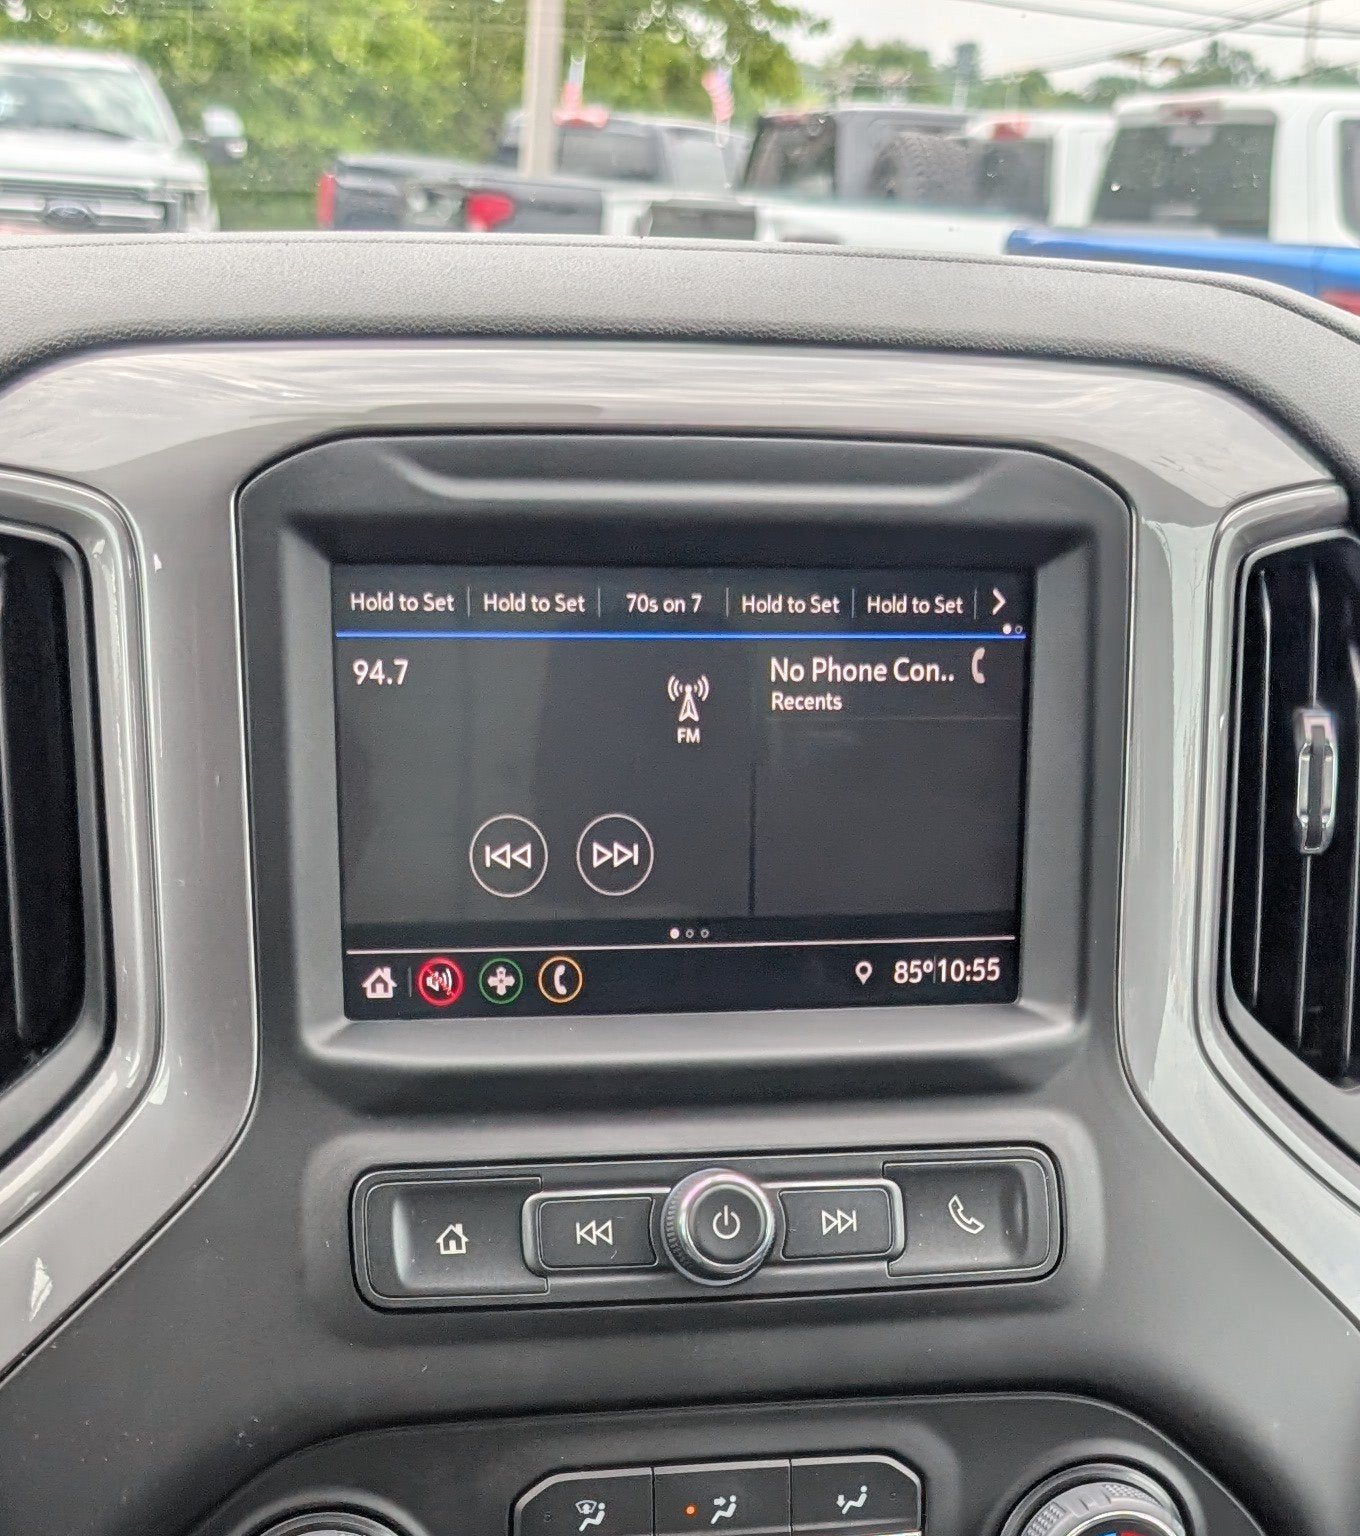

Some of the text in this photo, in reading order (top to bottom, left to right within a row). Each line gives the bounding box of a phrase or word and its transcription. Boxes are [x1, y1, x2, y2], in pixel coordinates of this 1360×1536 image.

[350, 591, 455, 613] Hold to Set
[483, 591, 586, 613] Hold to Set
[626, 592, 703, 613] 70s on 7
[741, 593, 840, 614] Hold to Set
[867, 594, 964, 614] Hold to Set
[351, 658, 410, 686] 94.7
[770, 656, 805, 683] No
[811, 655, 887, 683] Phone
[771, 691, 843, 711] Recents
[677, 727, 701, 744] FM
